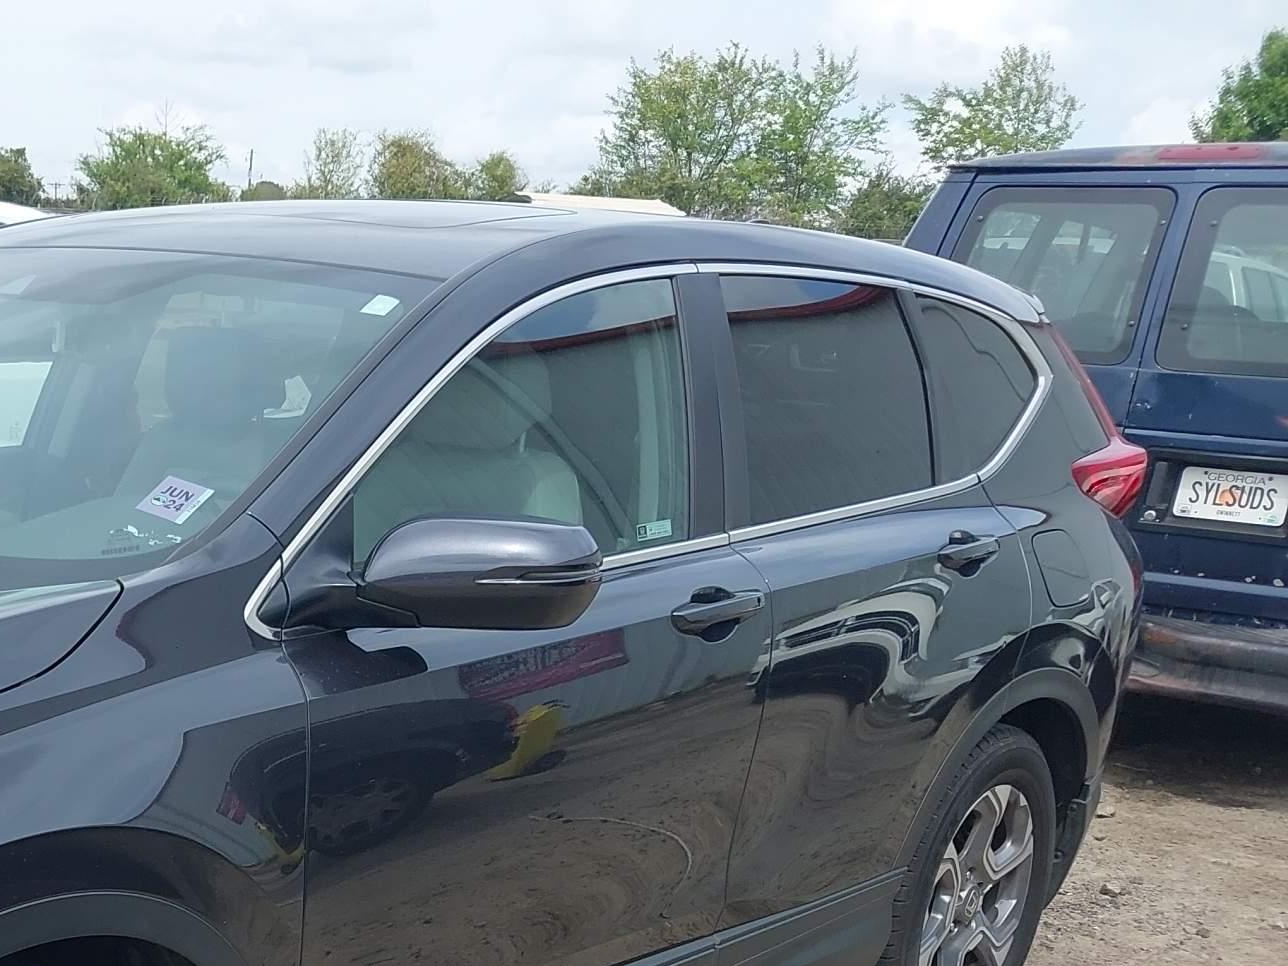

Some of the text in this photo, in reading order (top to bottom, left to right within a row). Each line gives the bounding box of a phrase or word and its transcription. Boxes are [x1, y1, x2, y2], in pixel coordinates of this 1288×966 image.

[1208, 471, 1266, 486] GEORGIA
[160, 485, 195, 503] JUN
[1188, 481, 1278, 511] SYLSUDS
[163, 499, 185, 512] 24
